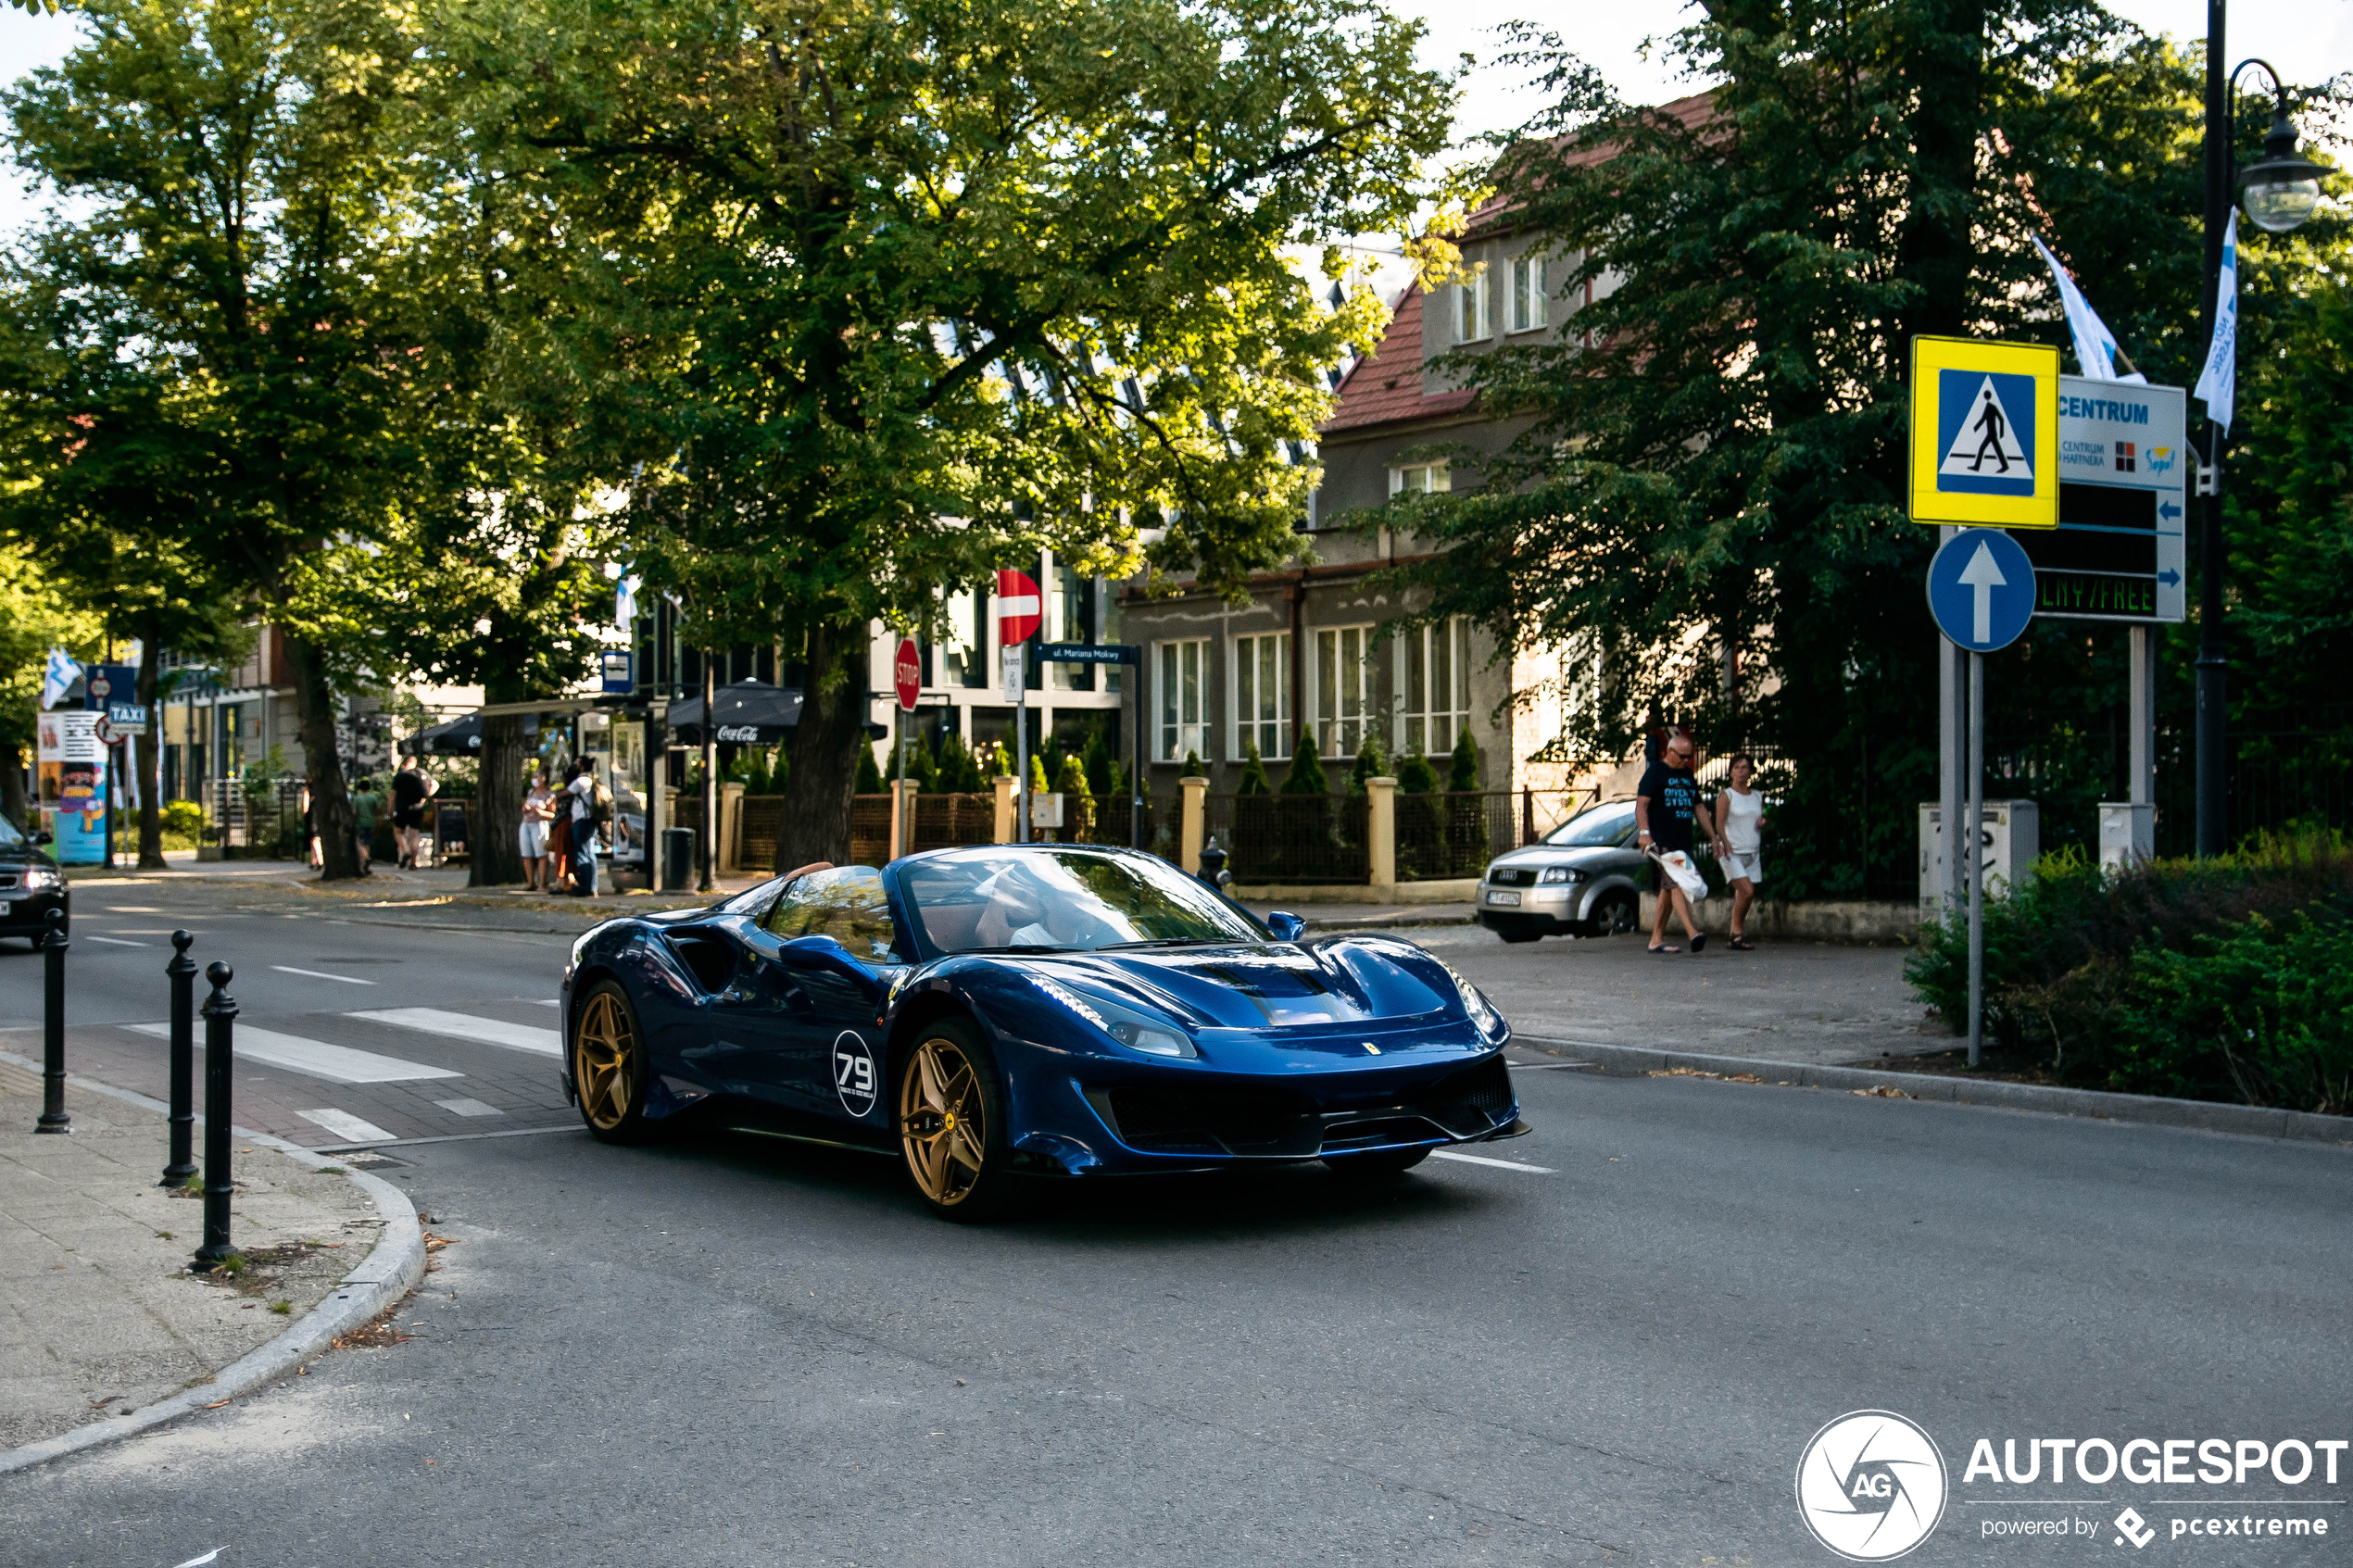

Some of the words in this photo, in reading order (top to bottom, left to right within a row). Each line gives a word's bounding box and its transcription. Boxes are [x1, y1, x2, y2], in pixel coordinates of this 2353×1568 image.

[2059, 395, 2148, 424] CENTRUM
[2062, 440, 2105, 454] CENTRUM
[1053, 648, 1063, 658] ul.
[1063, 649, 1092, 659] Mariana
[1093, 650, 1119, 660] Mokwy
[897, 662, 919, 685] STOP
[111, 706, 145, 722] TAXI
[837, 1052, 873, 1091] 79
